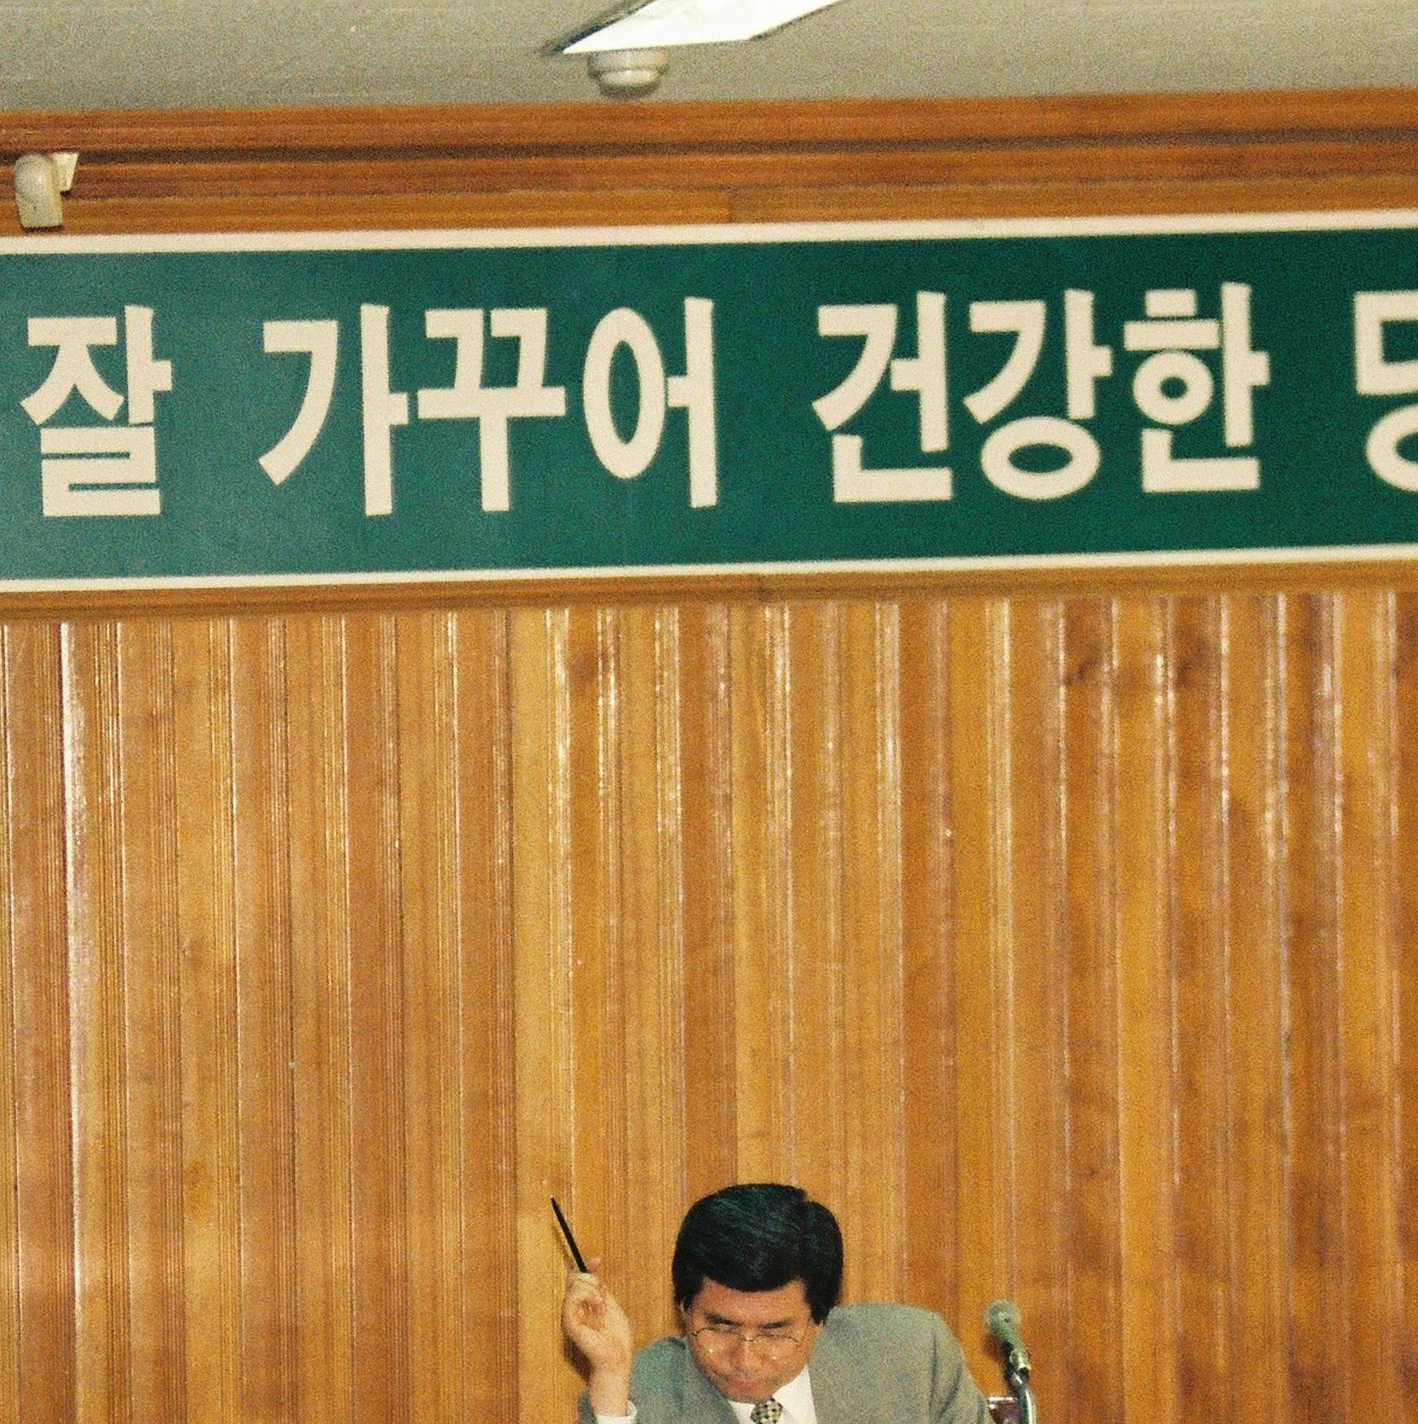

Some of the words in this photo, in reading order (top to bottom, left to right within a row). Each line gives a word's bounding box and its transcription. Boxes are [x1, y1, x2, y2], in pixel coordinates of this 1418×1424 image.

[20, 305, 173, 517] 잘
[258, 297, 717, 516] 가꾸어
[813, 282, 1270, 504] 건강한
